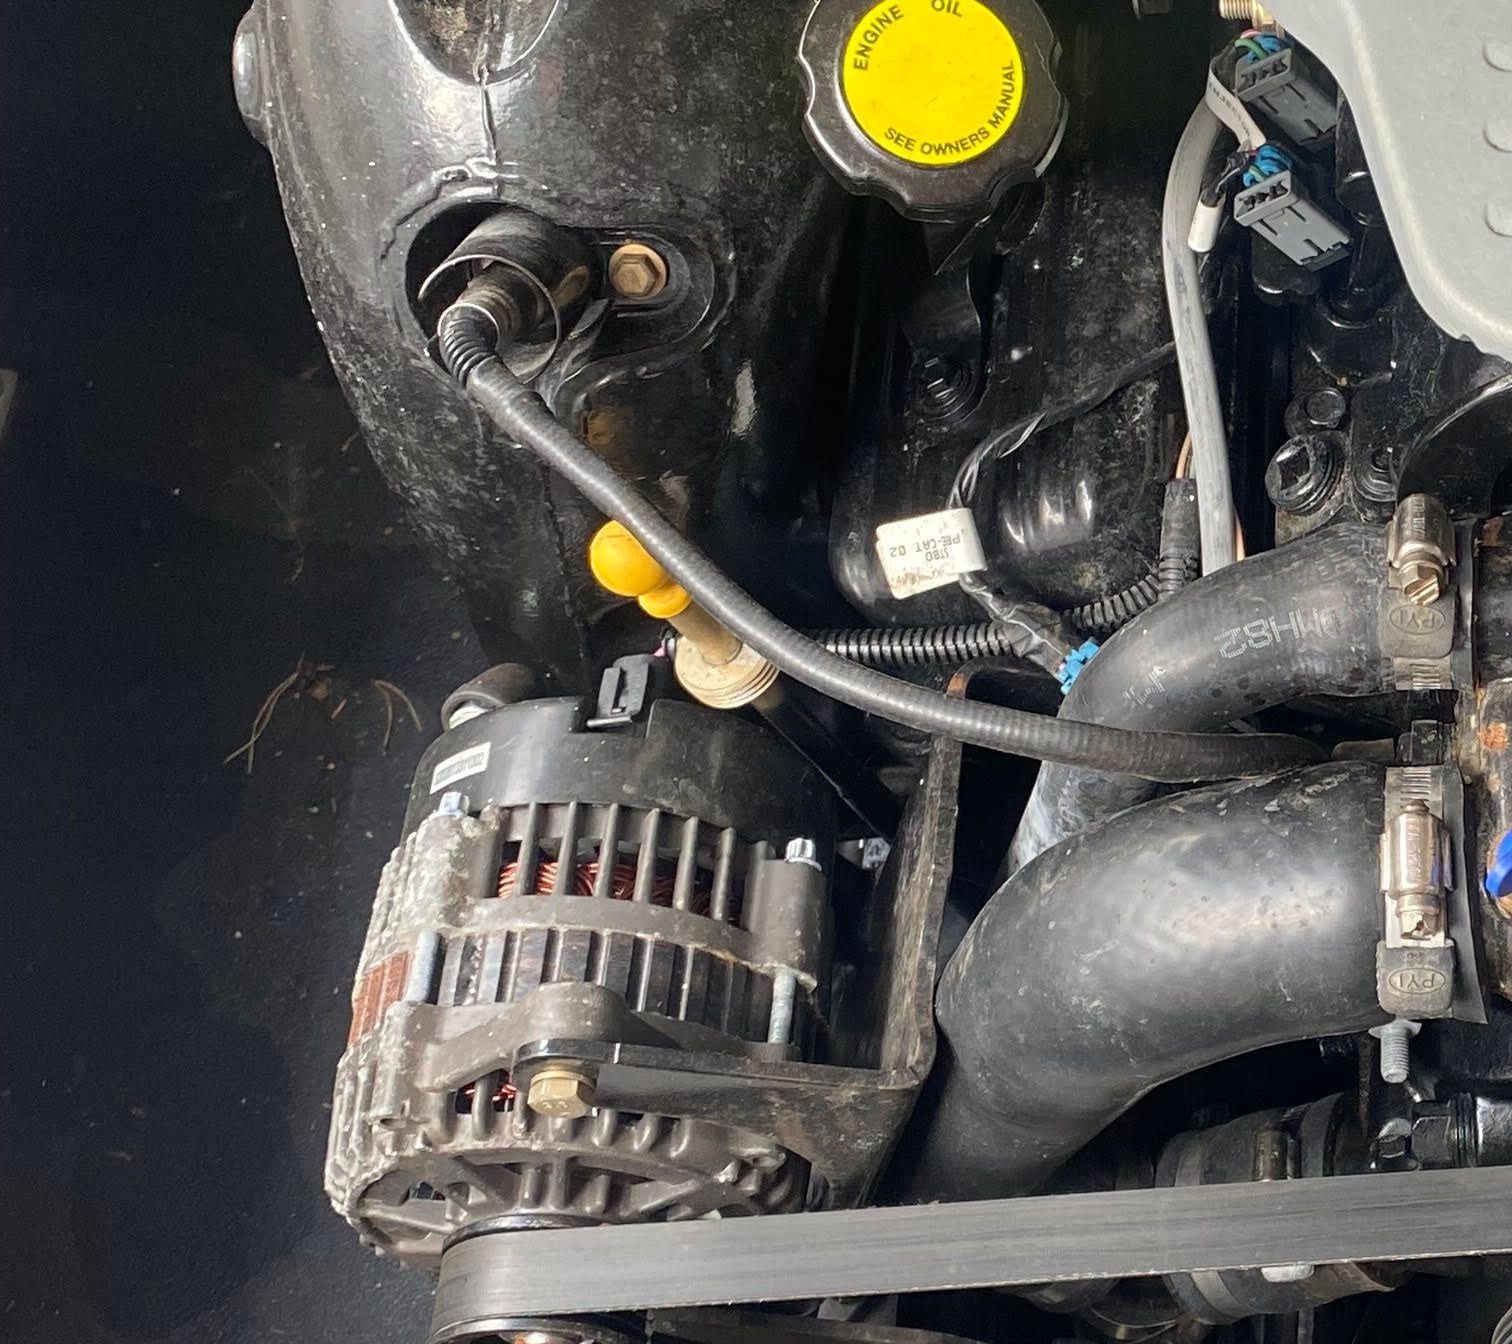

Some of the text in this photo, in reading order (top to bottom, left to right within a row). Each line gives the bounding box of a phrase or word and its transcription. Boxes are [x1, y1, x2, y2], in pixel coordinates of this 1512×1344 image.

[852, 4, 905, 72] ENGINE
[883, 59, 1016, 155] SEE OWNERS MANUAL
